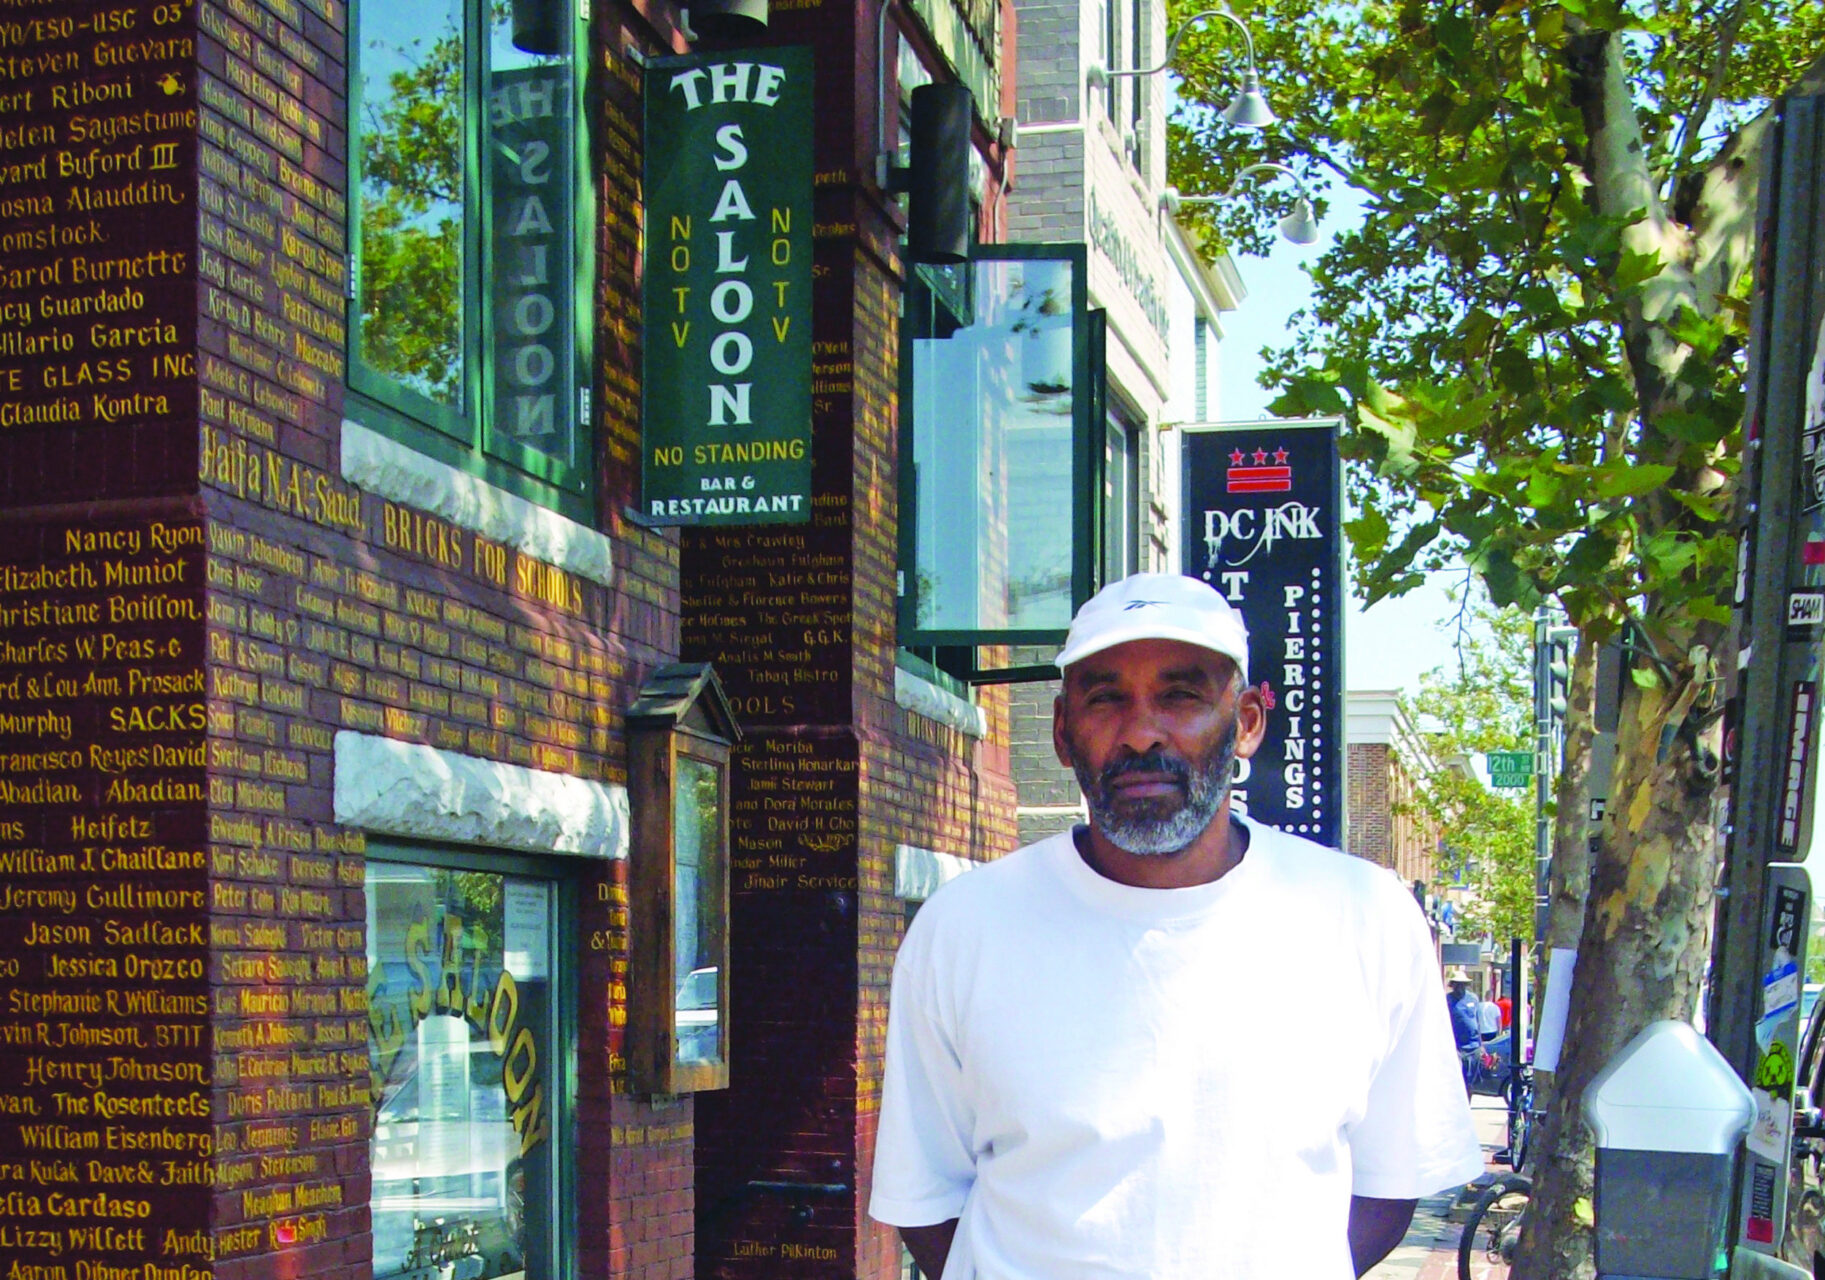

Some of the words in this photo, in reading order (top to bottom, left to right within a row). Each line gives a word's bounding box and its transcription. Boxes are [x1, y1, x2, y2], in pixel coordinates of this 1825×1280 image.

[94, 37, 193, 67] Guevara
[52, 75, 134, 109] Riboni
[669, 62, 787, 111] THE
[68, 108, 197, 145] Sagastume
[57, 144, 143, 179] Buford
[67, 179, 185, 211] Alauddin
[671, 215, 691, 272] NO
[771, 207, 791, 265] NO
[71, 250, 187, 284] Burnette
[706, 124, 756, 426] SALOON
[40, 286, 144, 318] Guardado
[672, 288, 691, 348] TV
[772, 282, 790, 343] TV
[90, 318, 179, 348] Garcia
[43, 358, 132, 389] GLASS
[1, 397, 81, 427] Claudia
[93, 391, 171, 422] Kontra
[654, 447, 683, 467] NO
[694, 439, 805, 465] STANDING
[700, 477, 737, 491] BAR
[741, 475, 756, 489] &
[651, 494, 804, 516] RESTAURANT
[66, 528, 141, 555] Nancy
[150, 522, 205, 554] Ryon
[1203, 508, 1255, 546] DC
[1264, 502, 1324, 541] INK
[384, 502, 463, 568] BRICKS
[474, 537, 506, 585] FOR
[516, 554, 582, 615] SCHOOLS
[27, 677, 41, 700] &
[43, 671, 78, 698] Lou
[82, 671, 122, 696] Ann
[128, 668, 205, 697] Prosack
[1283, 586, 1306, 809] PIERCINGS
[0, 710, 72, 741] Murphy
[110, 704, 206, 733] SACKS
[90, 744, 150, 774] Reyes
[152, 741, 207, 768] David
[106, 777, 205, 804] Abadian
[70, 813, 152, 842] Heifetz
[0, 848, 76, 874] William
[0, 883, 77, 914] Jeremy
[23, 921, 92, 946] Jason
[104, 919, 207, 945] Sadlack
[47, 952, 119, 978] Jessica
[124, 953, 205, 980] Orozco
[9, 988, 101, 1018] Stephanie
[124, 988, 208, 1016] Williams
[52, 1023, 148, 1049] Johnson
[23, 1056, 103, 1088] Henry
[104, 1056, 211, 1085] Johnson
[51, 1092, 90, 1116] The
[19, 1125, 100, 1150] William
[105, 1124, 212, 1158] Eisenberg
[87, 1160, 136, 1184] Dave
[137, 1160, 154, 1184] &
[47, 1191, 152, 1218] Cardaso
[0, 1226, 62, 1256] Lizzy
[69, 1227, 147, 1251] Willett
[162, 1229, 216, 1261] Andy
